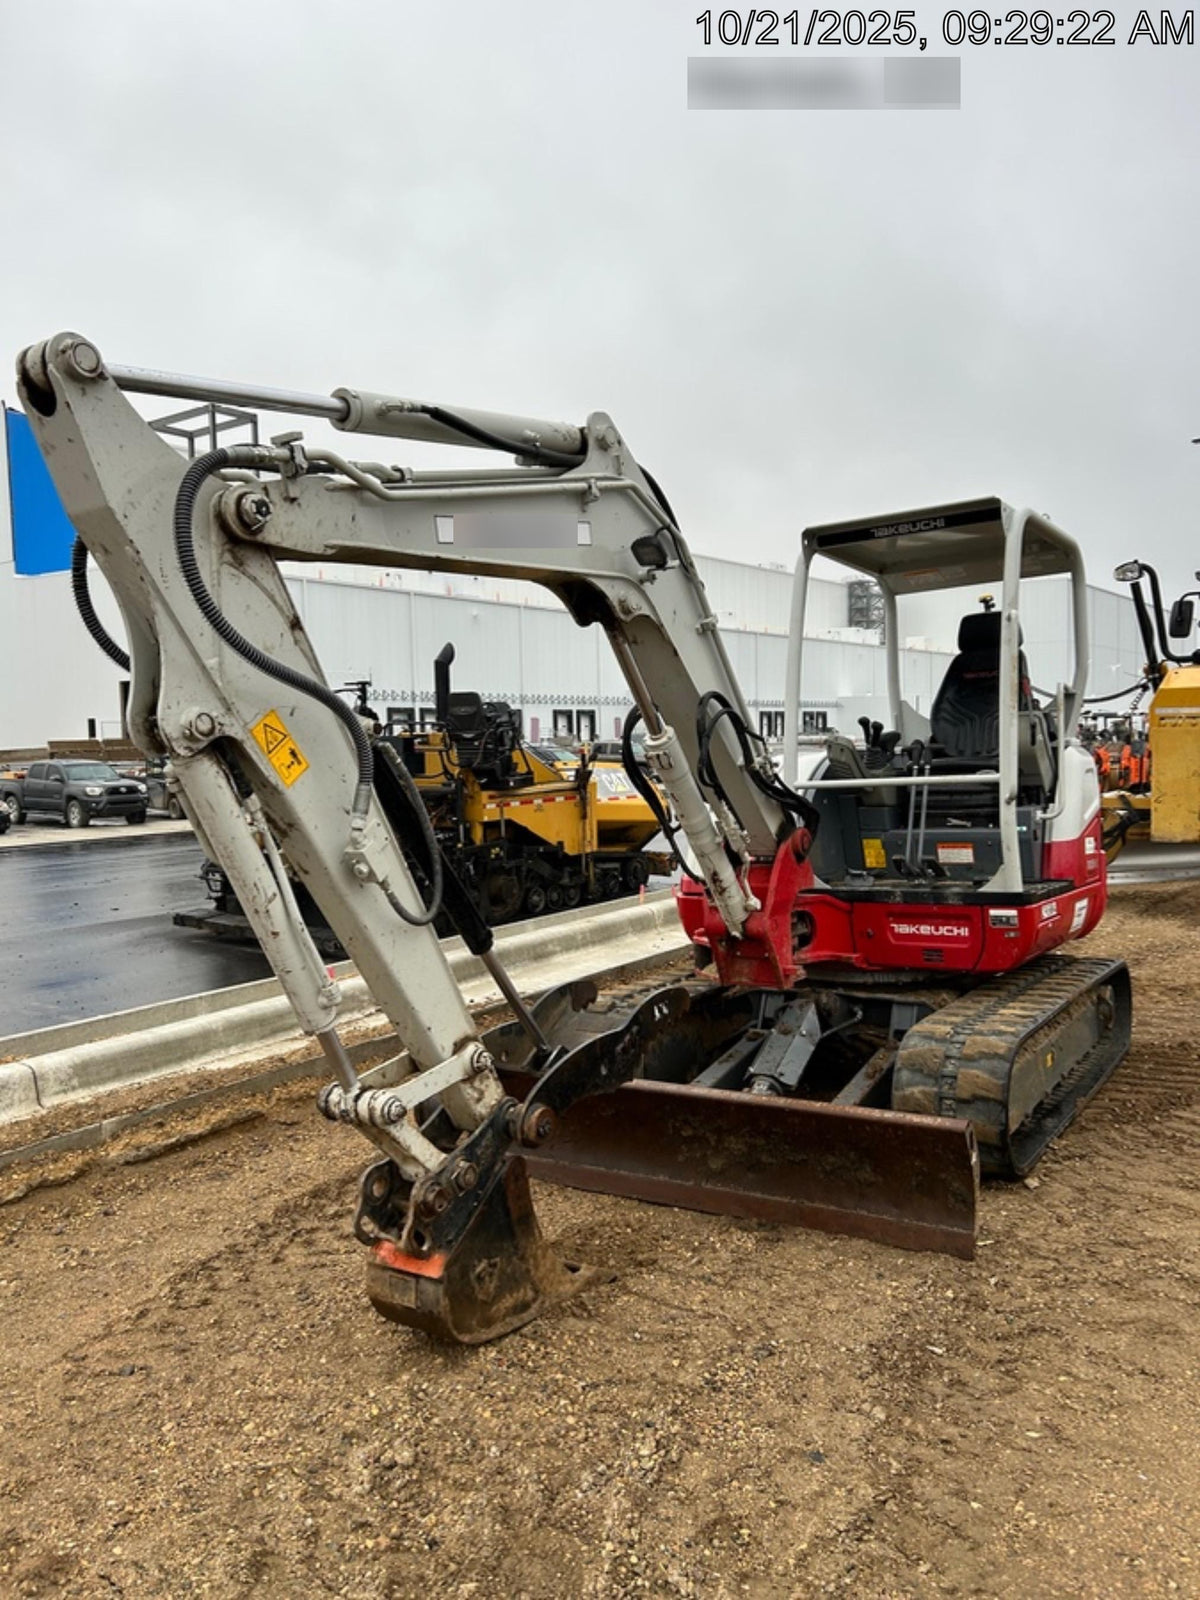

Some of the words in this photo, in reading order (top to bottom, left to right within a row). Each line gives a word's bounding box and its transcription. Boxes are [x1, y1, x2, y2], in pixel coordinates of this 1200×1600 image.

[869, 517, 946, 538] TAKEUCHI
[601, 772, 630, 792] CAT
[889, 923, 970, 937] TAKEUCHI
